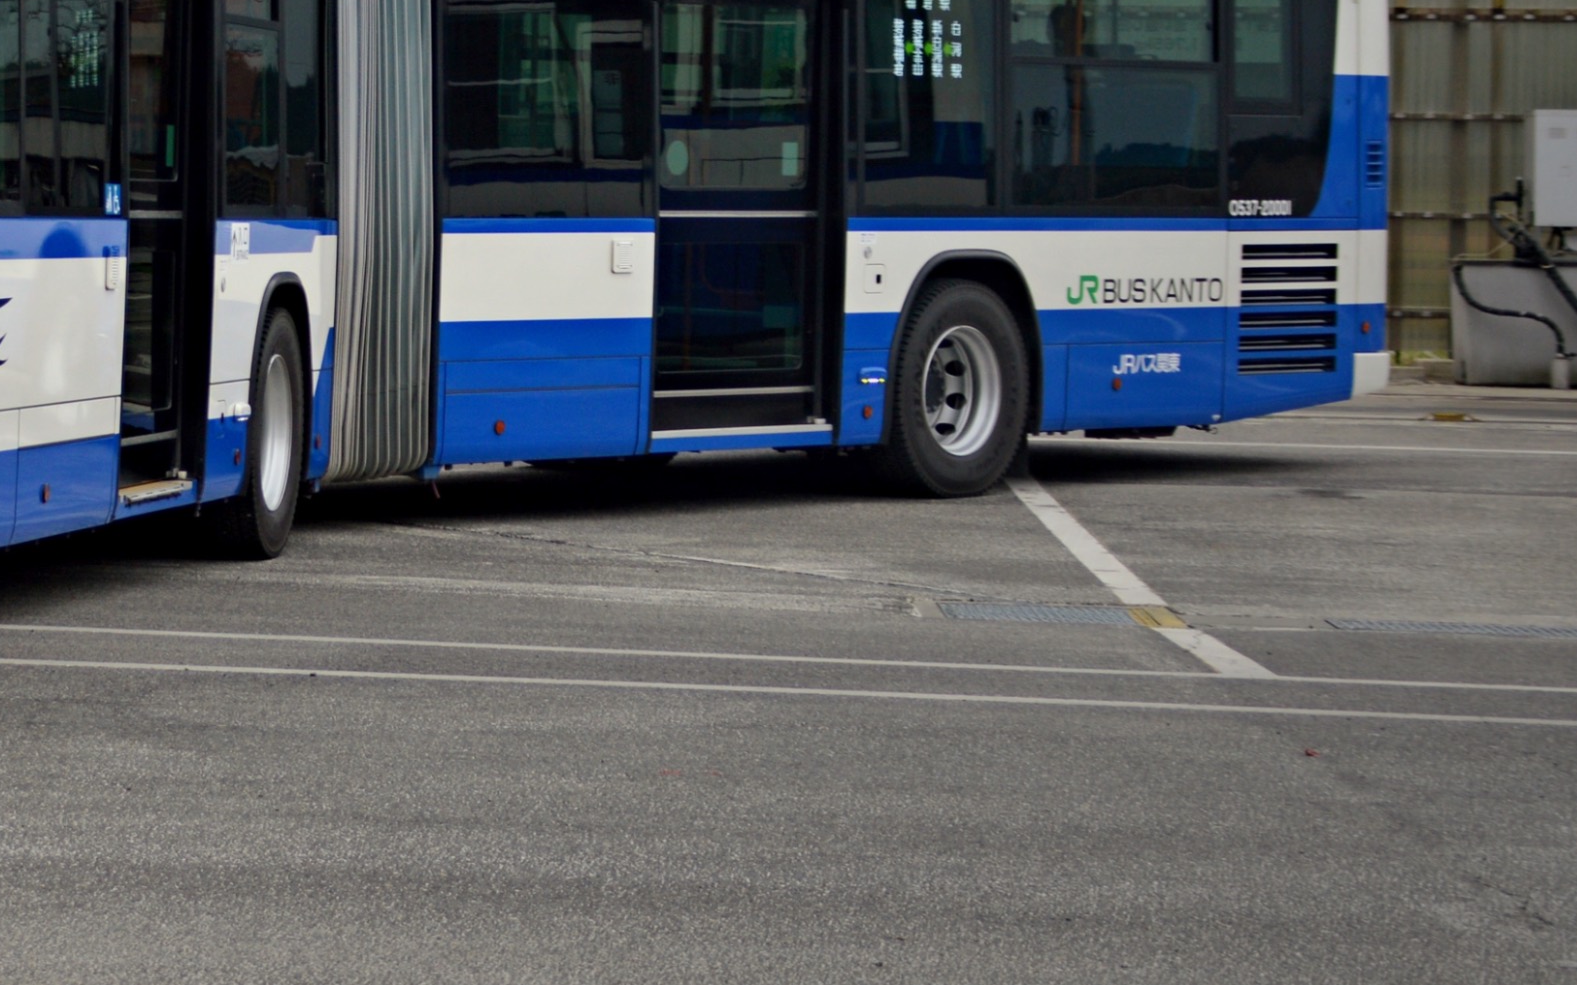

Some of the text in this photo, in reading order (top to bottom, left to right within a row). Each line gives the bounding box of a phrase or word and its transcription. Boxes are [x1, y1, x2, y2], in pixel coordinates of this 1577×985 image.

[1066, 275, 1223, 305] JR BUS KANTO
[1112, 353, 1182, 375] JRバス関東
